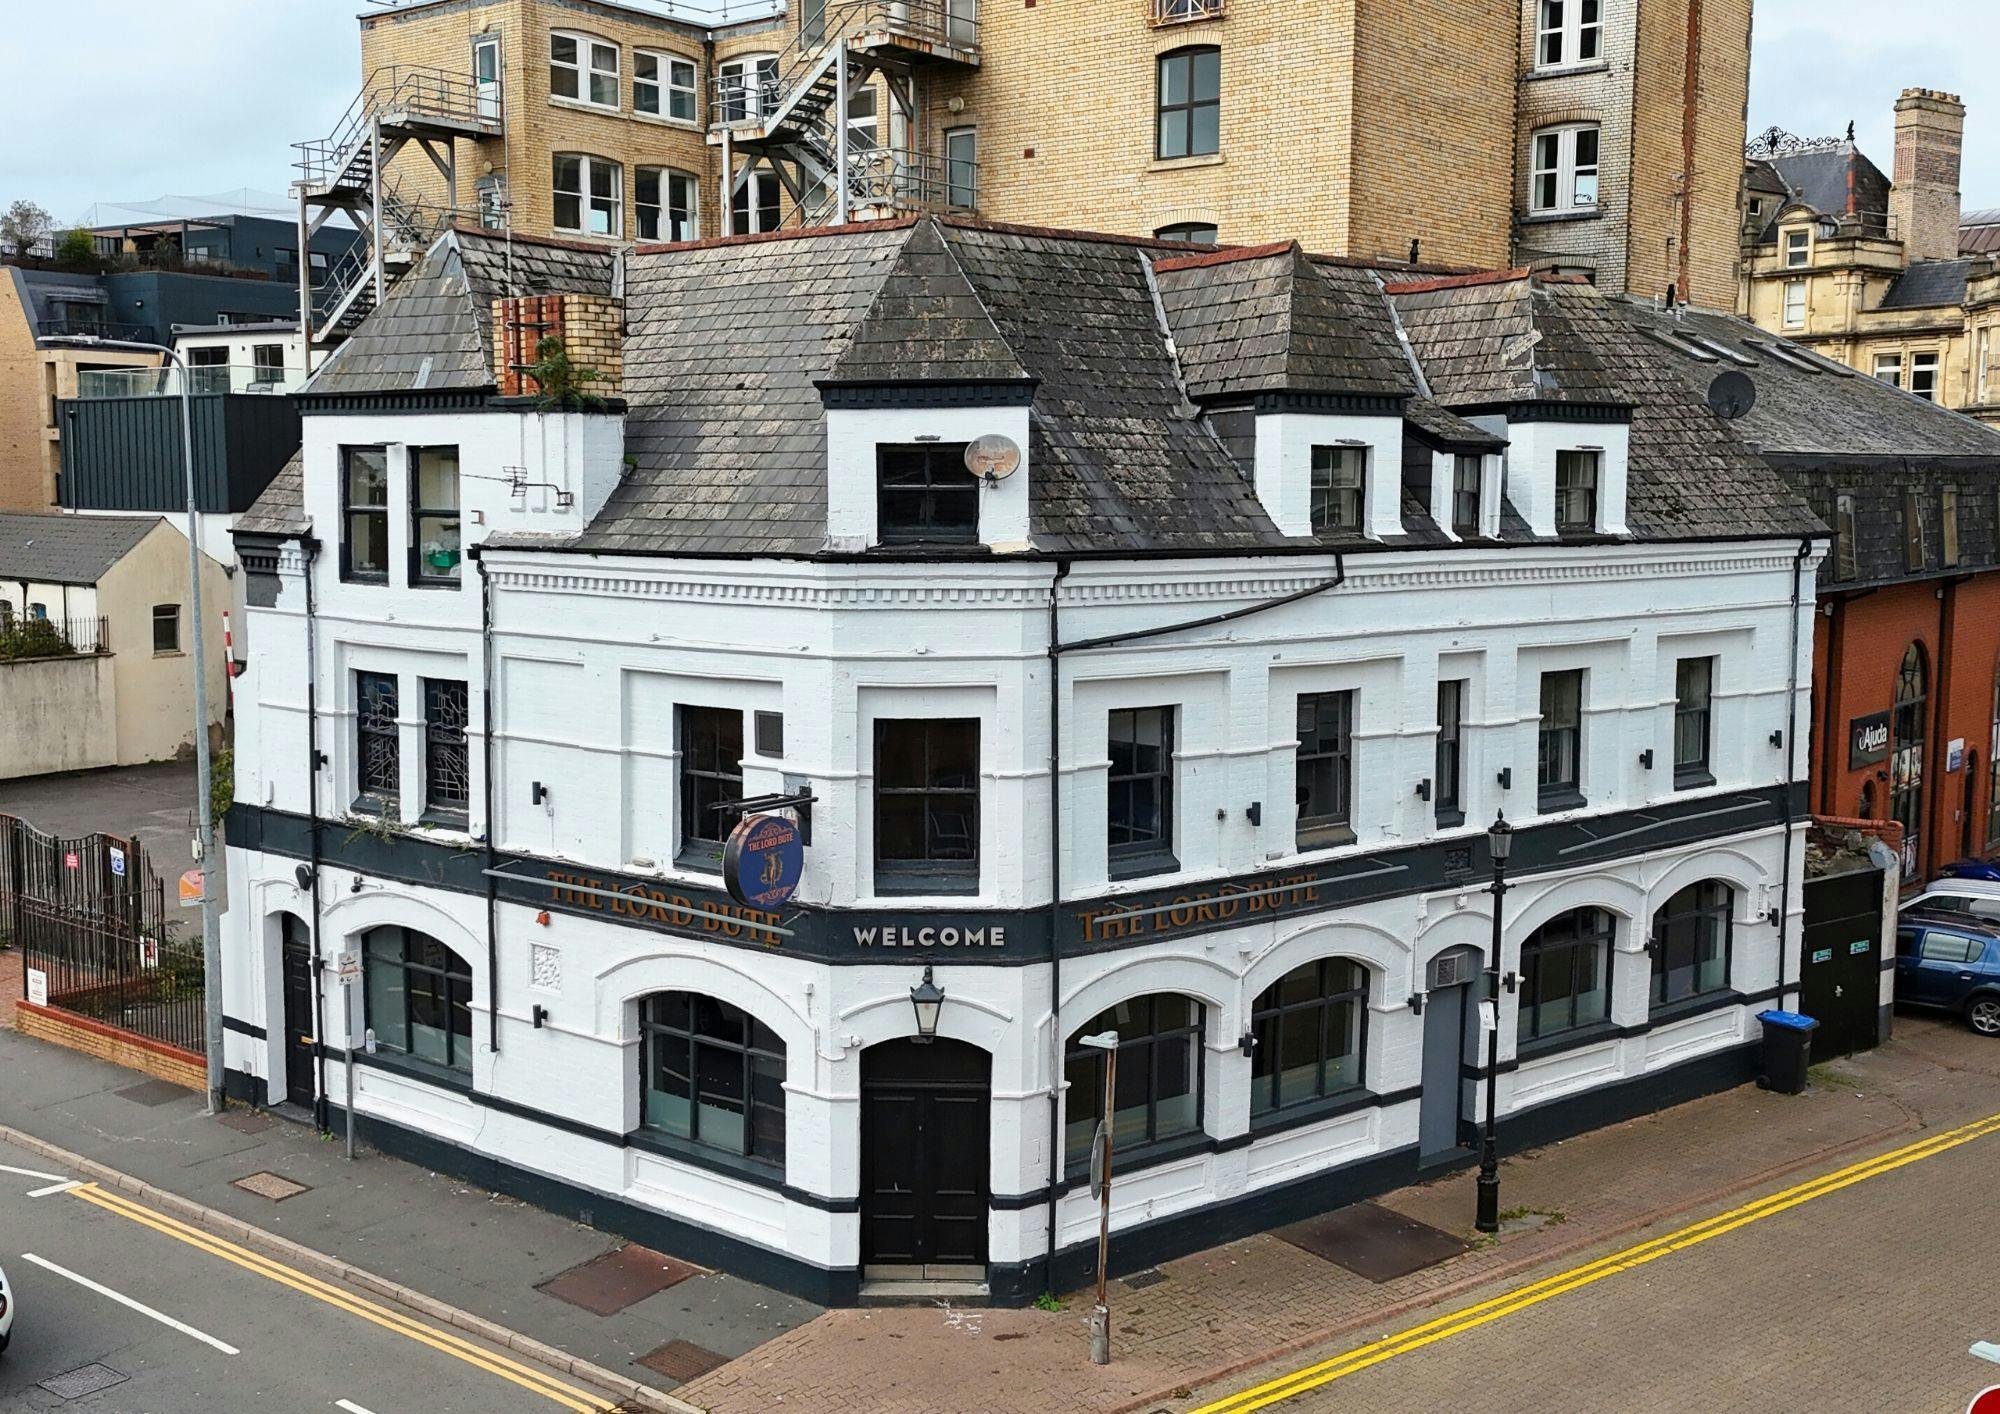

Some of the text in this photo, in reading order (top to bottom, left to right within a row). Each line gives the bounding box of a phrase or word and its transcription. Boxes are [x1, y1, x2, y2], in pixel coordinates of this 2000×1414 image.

[1859, 723, 1888, 752] Ajuda
[749, 832, 793, 852] THE LORD BUTE
[549, 871, 784, 946] THE LORD BUTE
[1076, 872, 1320, 943] THE LORD BUTE
[853, 926, 1005, 947] WELCOME
